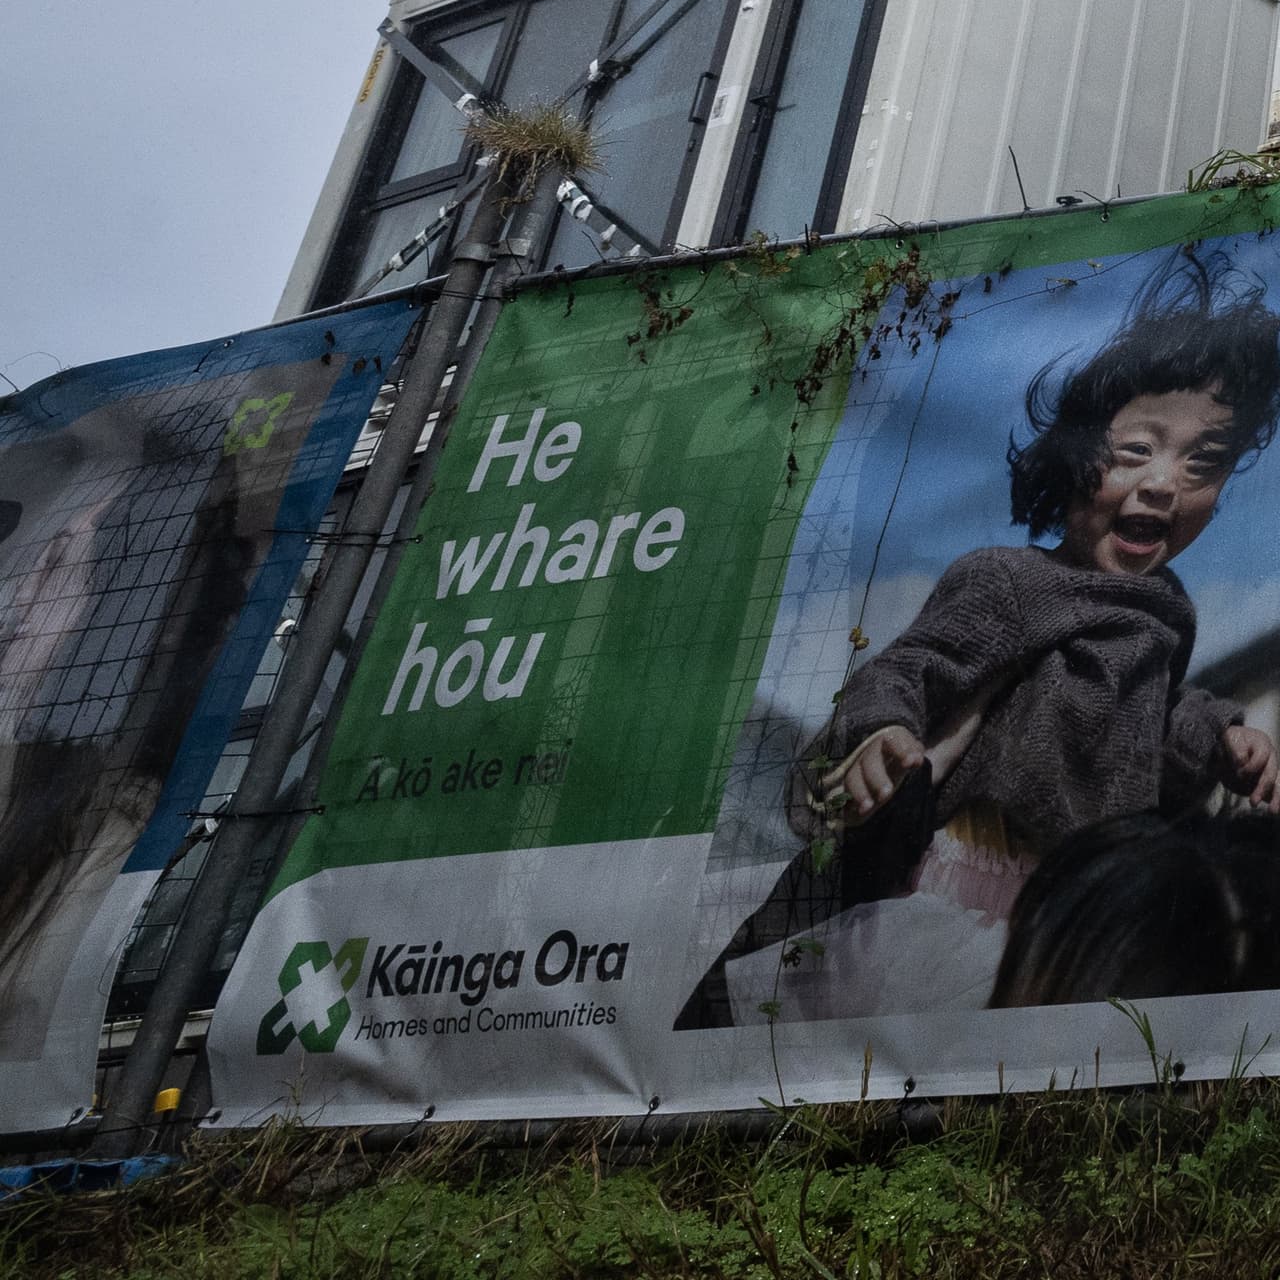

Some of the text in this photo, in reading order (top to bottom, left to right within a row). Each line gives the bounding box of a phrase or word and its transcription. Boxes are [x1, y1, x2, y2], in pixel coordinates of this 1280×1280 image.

[466, 407, 582, 493] He
[436, 503, 685, 600] whare
[381, 617, 547, 716] hōu
[354, 737, 573, 805] Ā kō ake nei
[365, 929, 631, 1007] Kāinga Ora
[354, 1001, 617, 1041] Homes and Communities
